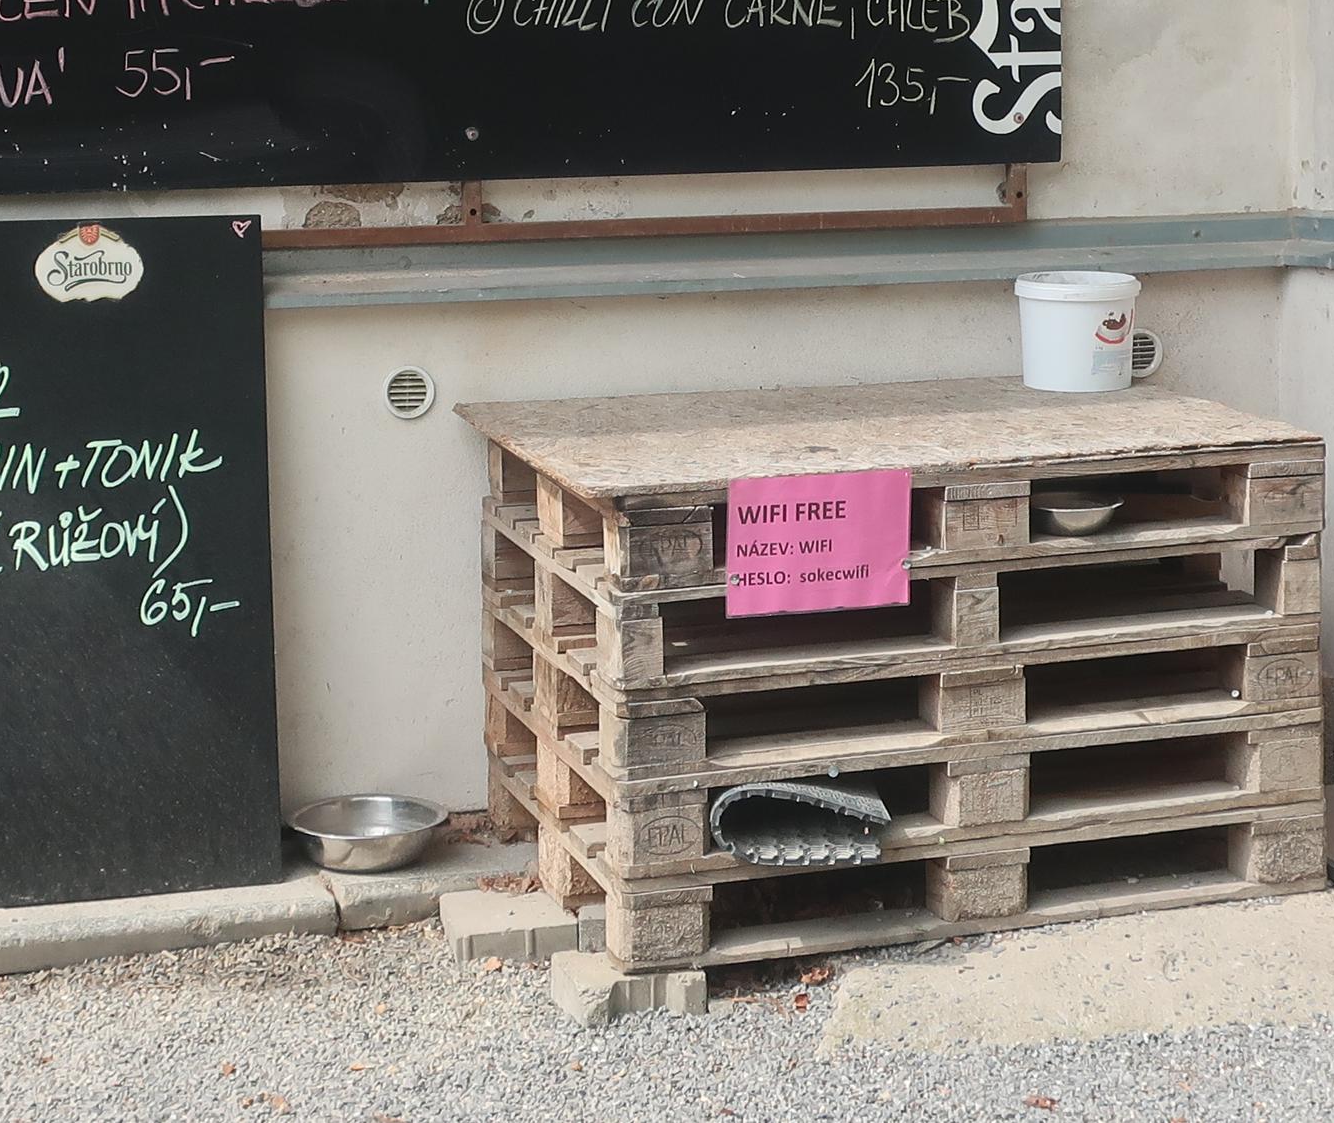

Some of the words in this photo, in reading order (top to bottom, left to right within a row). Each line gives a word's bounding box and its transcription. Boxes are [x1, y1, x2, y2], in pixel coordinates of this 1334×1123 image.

[47, 250, 133, 292] Starobrno
[738, 505, 787, 525] WIFI
[796, 500, 847, 522] FREE
[736, 540, 794, 557] NÁZEV:
[799, 539, 833, 555] WIFI
[737, 571, 791, 587] HESLO:
[800, 565, 869, 583] sokecwifi
